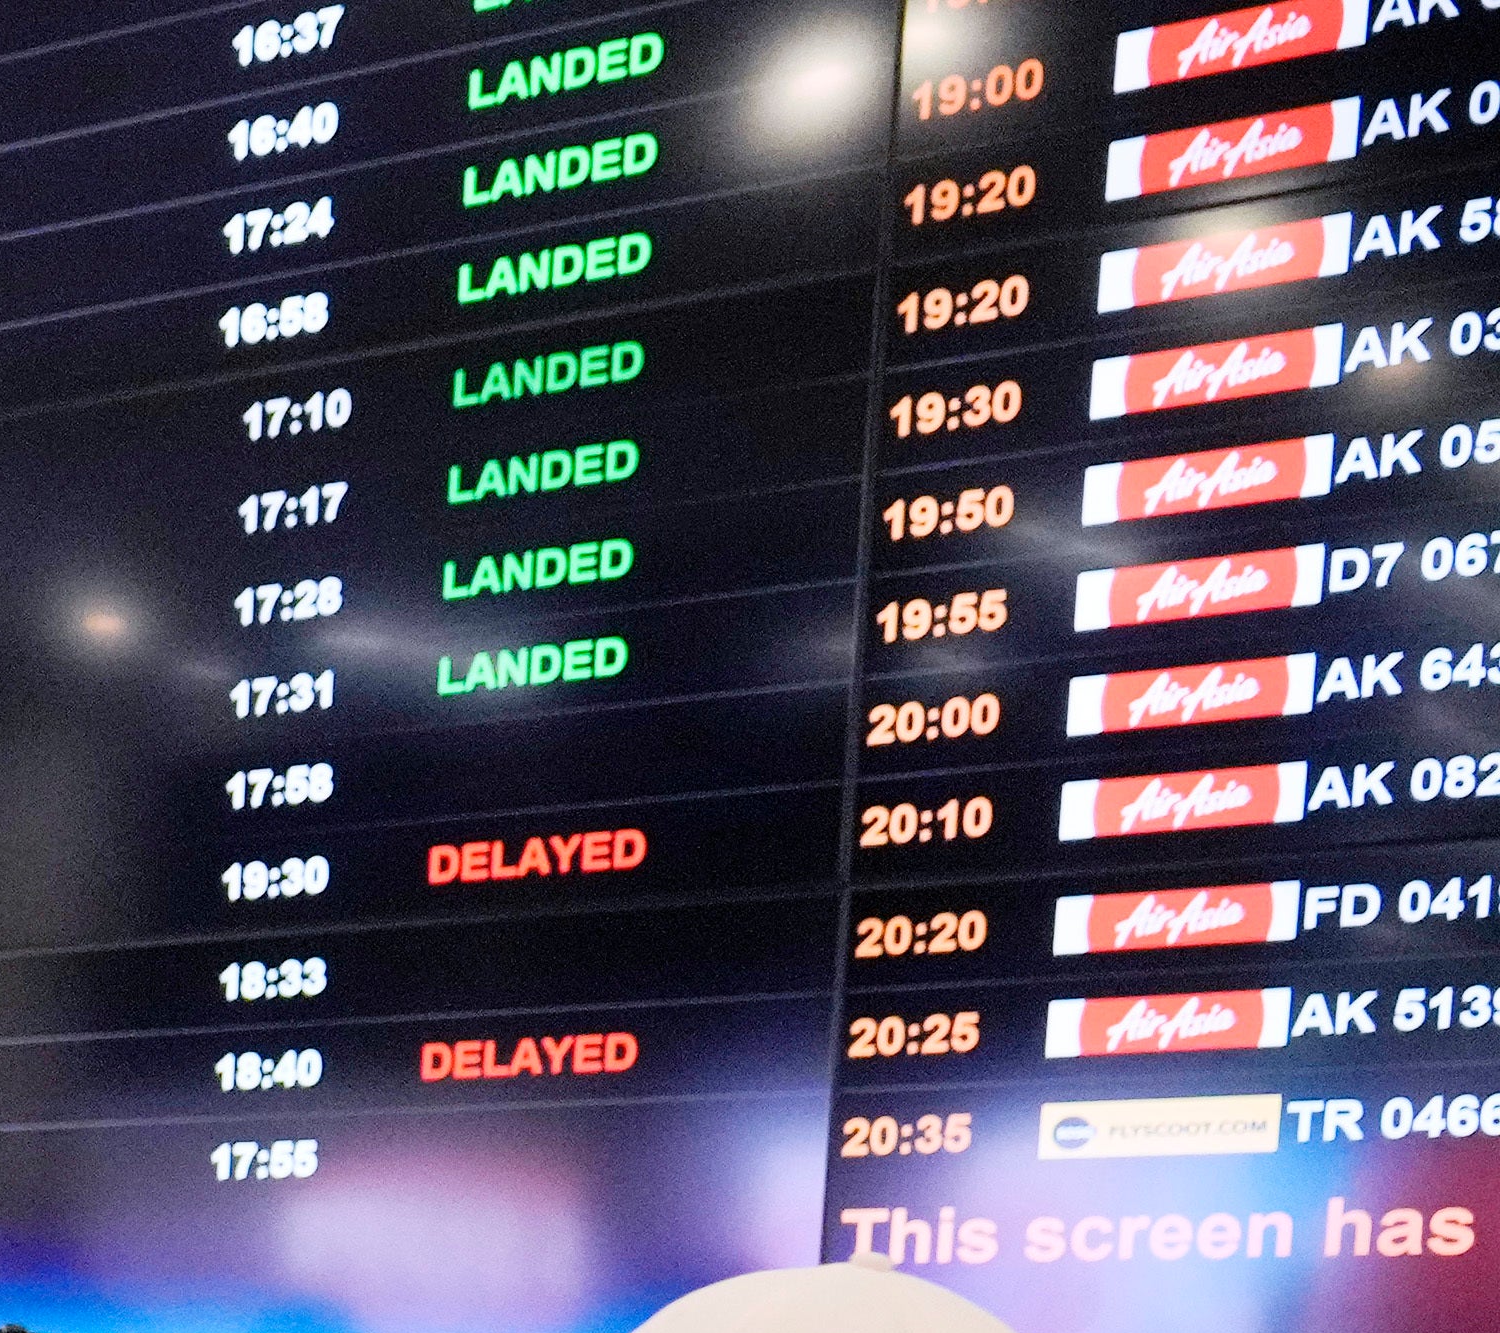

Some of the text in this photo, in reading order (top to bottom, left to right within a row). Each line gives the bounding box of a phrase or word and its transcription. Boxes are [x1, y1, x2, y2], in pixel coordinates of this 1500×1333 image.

[232, 4, 345, 67] 16:37
[911, 57, 1044, 121] 19:00
[1177, 7, 1313, 76] AirAsia
[227, 102, 339, 161] 16:40
[467, 32, 665, 110] LANDED
[222, 197, 335, 255] 17:24
[462, 131, 659, 208] LANDED
[903, 164, 1037, 226] 19:20
[1169, 117, 1304, 187] AirAsia
[1362, 88, 1451, 147] AK
[218, 292, 330, 348] 16:58
[457, 232, 653, 305] LANDED
[896, 273, 1030, 334] 19:20
[1161, 232, 1295, 300] AirAsia
[1353, 204, 1444, 263] AK
[243, 388, 352, 442] 17:10
[452, 341, 646, 408] LANDED
[889, 379, 1023, 439] 19:30
[1152, 342, 1287, 408] AirAsia
[1344, 317, 1434, 373] AK
[238, 481, 348, 535] 17:17
[447, 439, 640, 504] LANDED
[882, 485, 1015, 542] 19:50
[1144, 451, 1278, 518] AirAsia
[1335, 428, 1424, 484] AK
[234, 577, 344, 627] 17:28
[442, 537, 635, 600] LANDED
[876, 588, 1009, 645] 19:55
[1136, 559, 1270, 621] AirAsia
[1328, 542, 1405, 593] D7
[229, 670, 336, 719] 17:31
[437, 636, 629, 695] LANDED
[866, 692, 1000, 748] 20:00
[1128, 666, 1262, 728] AirAsia
[1316, 651, 1404, 704] AK
[226, 762, 334, 810] 17:58
[859, 796, 994, 849] 20:10
[1120, 774, 1254, 833] AirAsia
[1308, 760, 1396, 811] AK
[221, 855, 330, 902] 19:30
[427, 828, 647, 886] DELAYED
[853, 910, 989, 960] 20:20
[1114, 891, 1247, 947] AirAsia
[1303, 883, 1383, 930] FD
[218, 957, 328, 1002] 18:33
[214, 1048, 324, 1092] 18:40
[420, 1032, 640, 1083] DELAYED
[846, 1011, 981, 1060] 20:25
[1107, 997, 1237, 1051] AirAsia
[1291, 990, 1378, 1037] AK
[211, 1139, 318, 1181] 17:55
[839, 1112, 973, 1159] 20:35
[1109, 1119, 1267, 1140] FLYSCOOT.COM
[1287, 1098, 1364, 1143] TR
[841, 1196, 1477, 1266] This screen has
